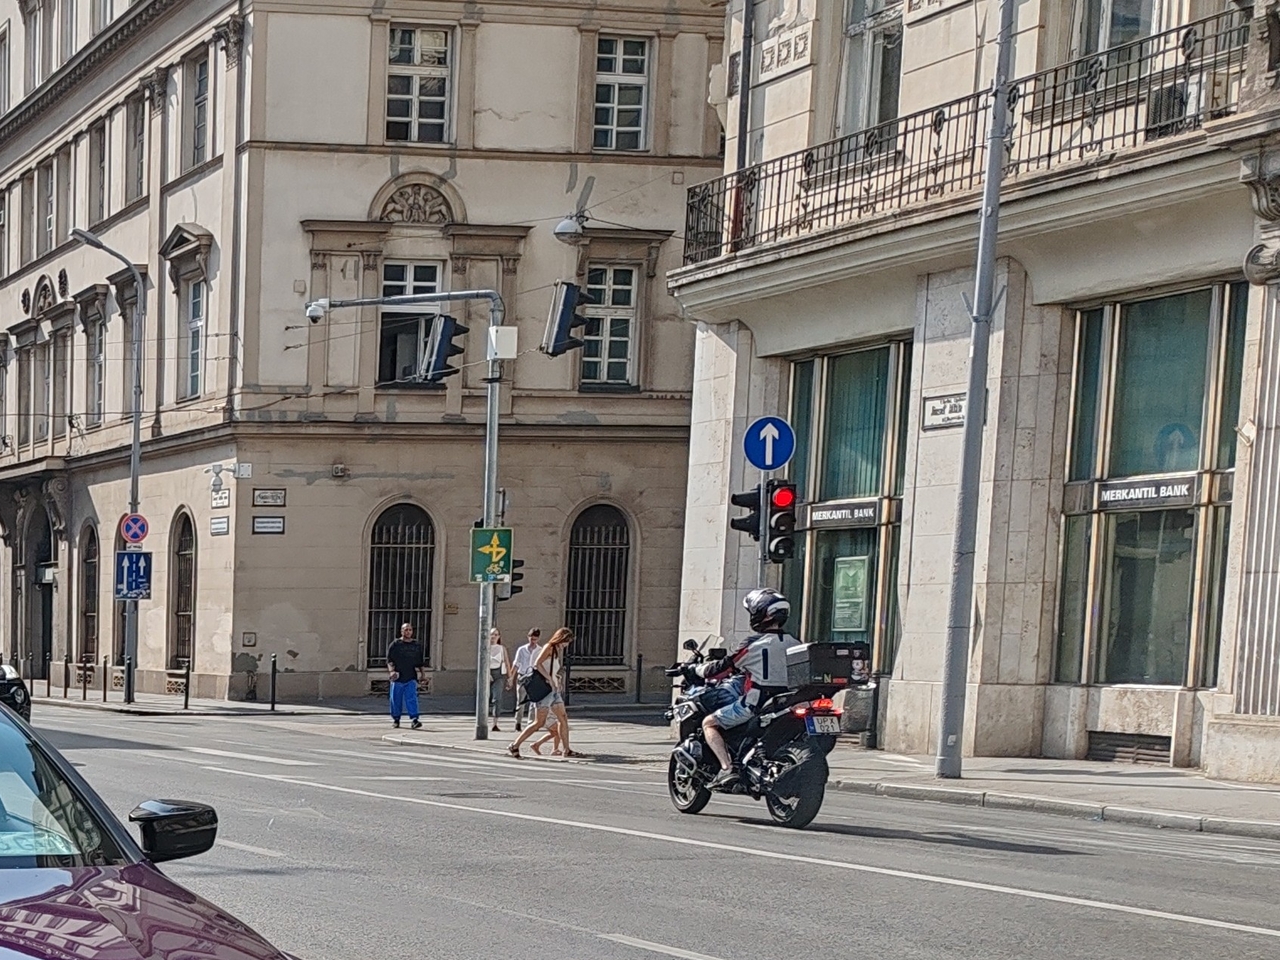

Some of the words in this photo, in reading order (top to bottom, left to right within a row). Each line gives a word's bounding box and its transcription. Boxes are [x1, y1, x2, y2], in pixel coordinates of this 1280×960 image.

[1101, 487, 1158, 502] MERKANTIL
[1159, 484, 1190, 498] BANK
[812, 510, 852, 521] MERKANTIL
[854, 507, 874, 518] BANK
[816, 717, 836, 725] UPX
[819, 724, 835, 732] 021
